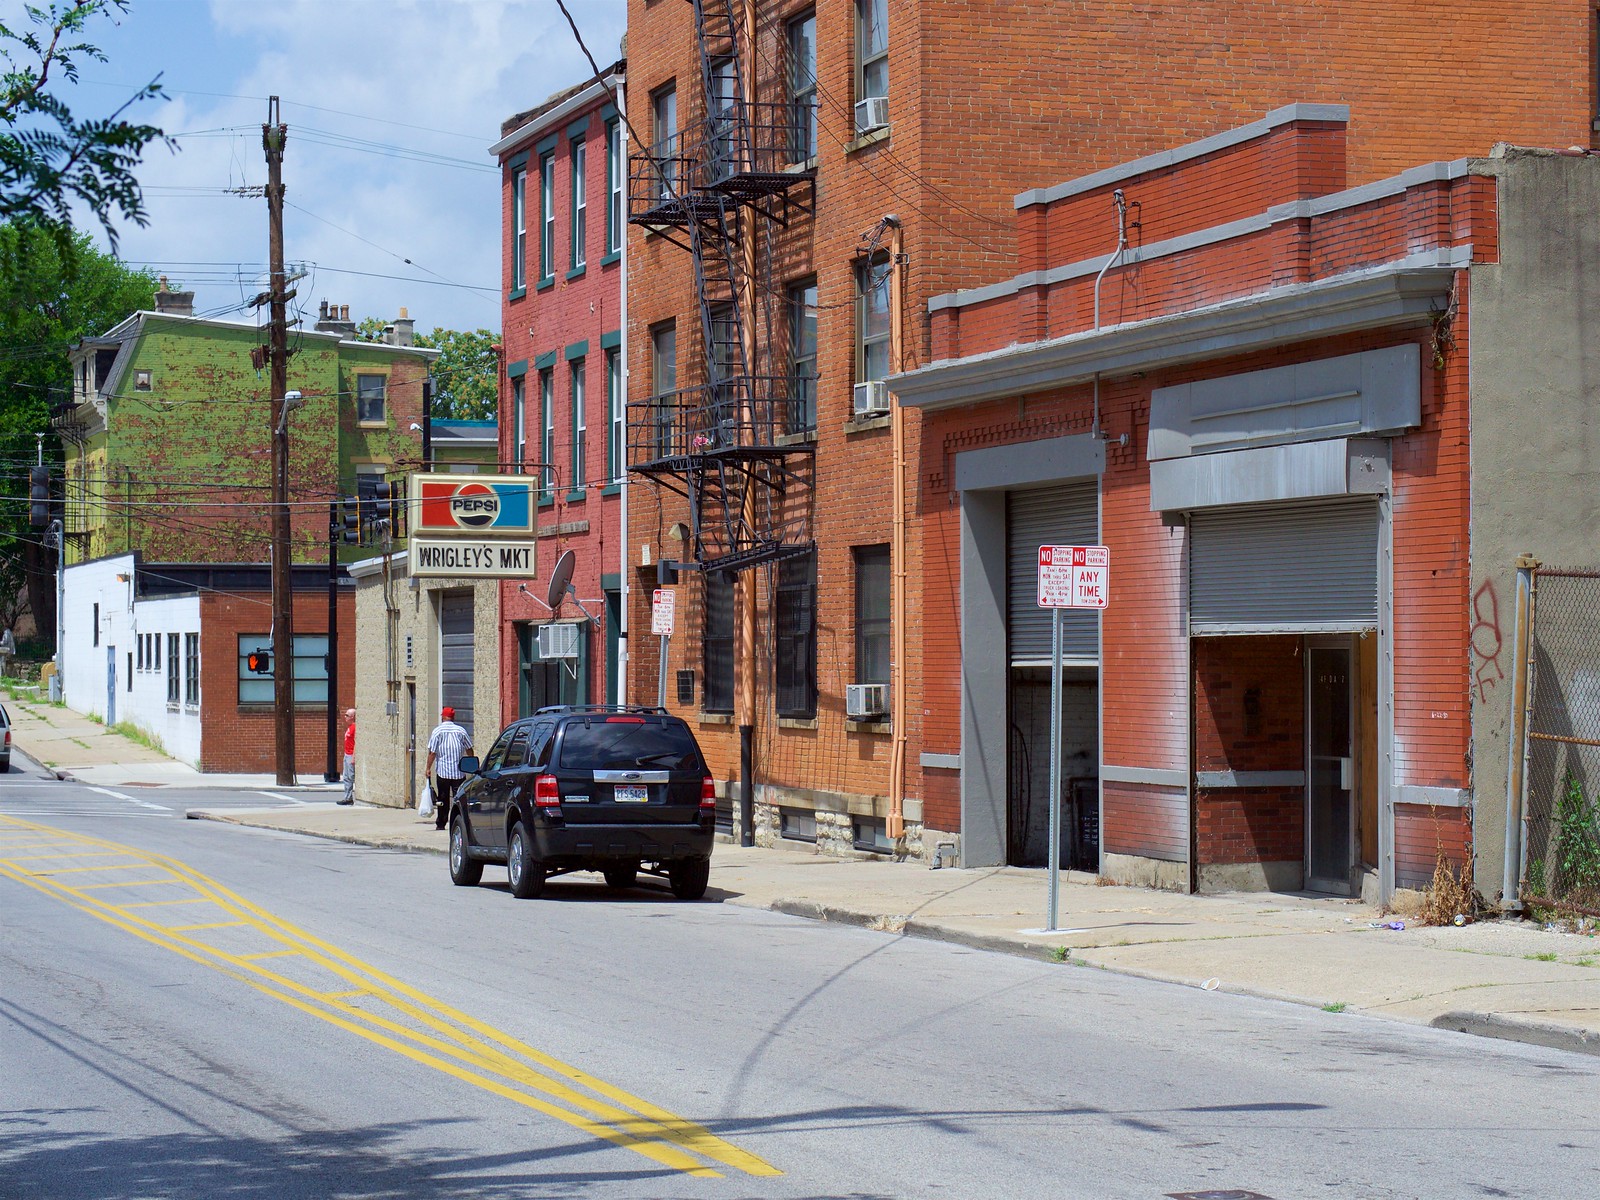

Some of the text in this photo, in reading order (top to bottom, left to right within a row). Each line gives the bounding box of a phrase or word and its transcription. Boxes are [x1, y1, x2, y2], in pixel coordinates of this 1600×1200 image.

[453, 499, 498, 511] PEPSI
[420, 544, 531, 569] WRIGLEY'S MKT
[1041, 550, 1051, 562] NO
[1074, 551, 1084, 562] NO
[1080, 571, 1100, 583] ANY
[1079, 585, 1100, 597] TIME
